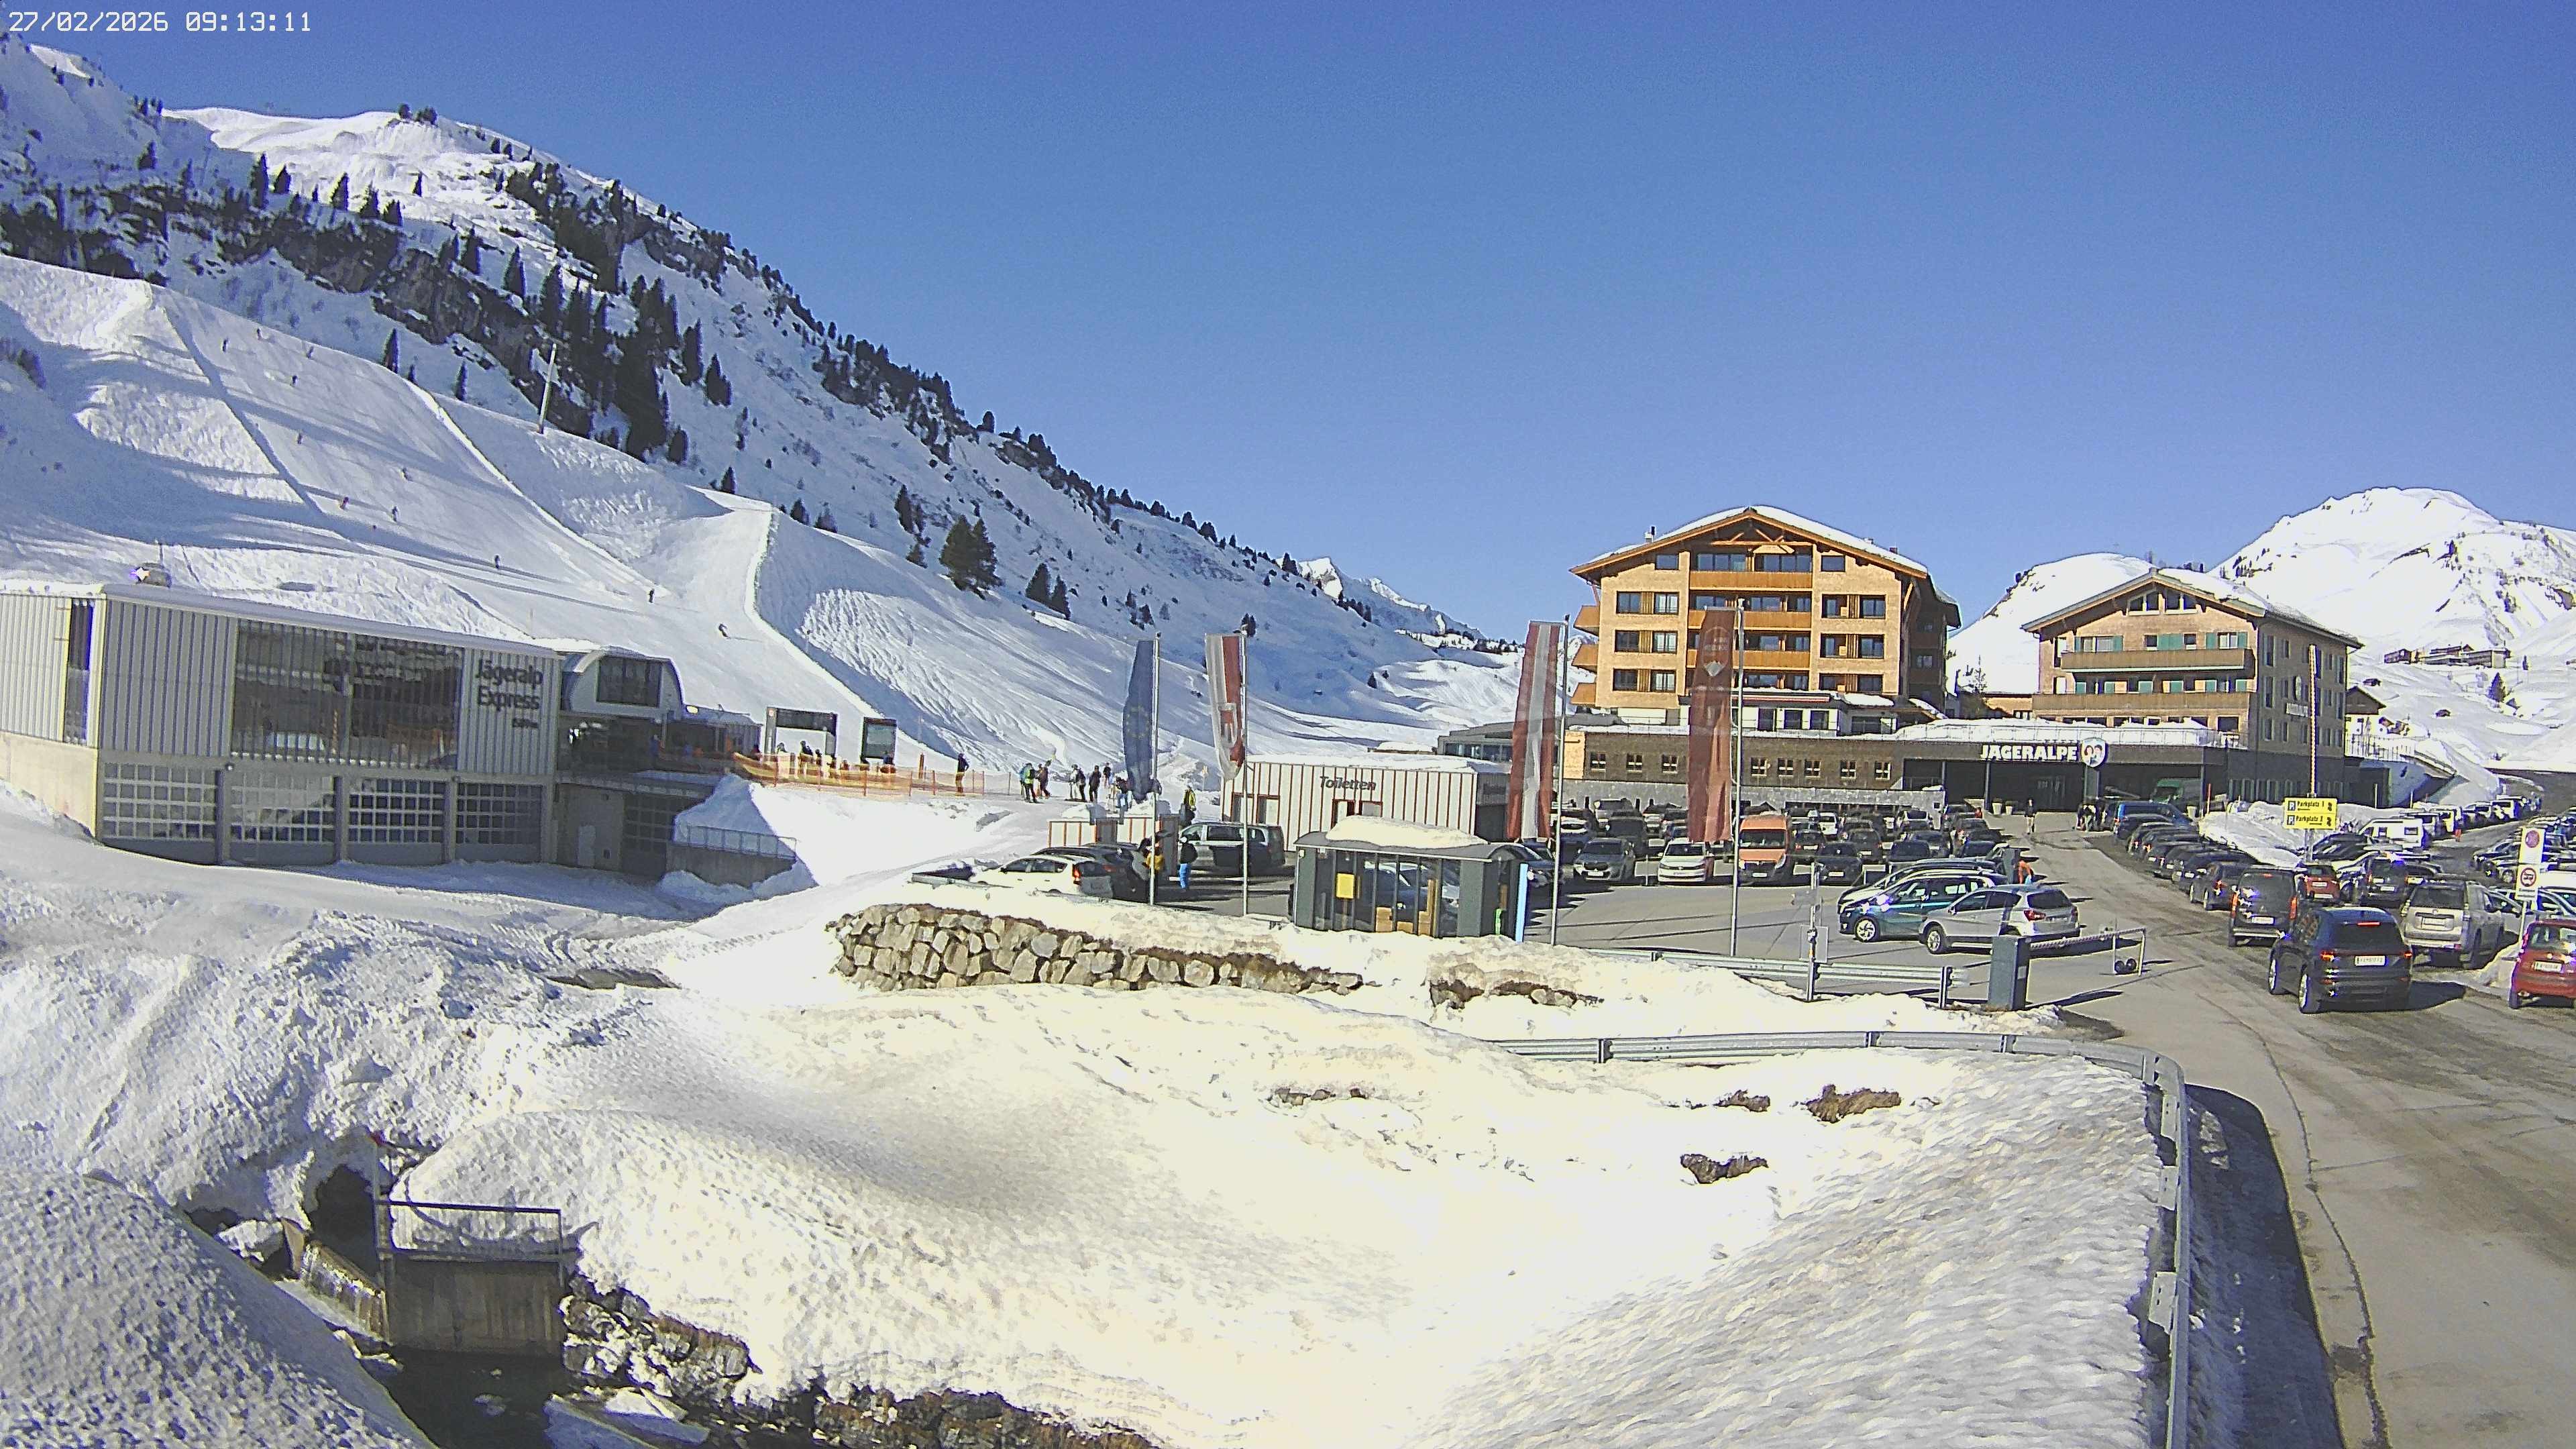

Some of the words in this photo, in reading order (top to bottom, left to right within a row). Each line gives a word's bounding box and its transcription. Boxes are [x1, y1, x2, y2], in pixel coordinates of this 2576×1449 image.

[475, 659, 543, 690] Jägeralp
[478, 686, 540, 712] Express
[1320, 775, 1377, 790] Toiletten
